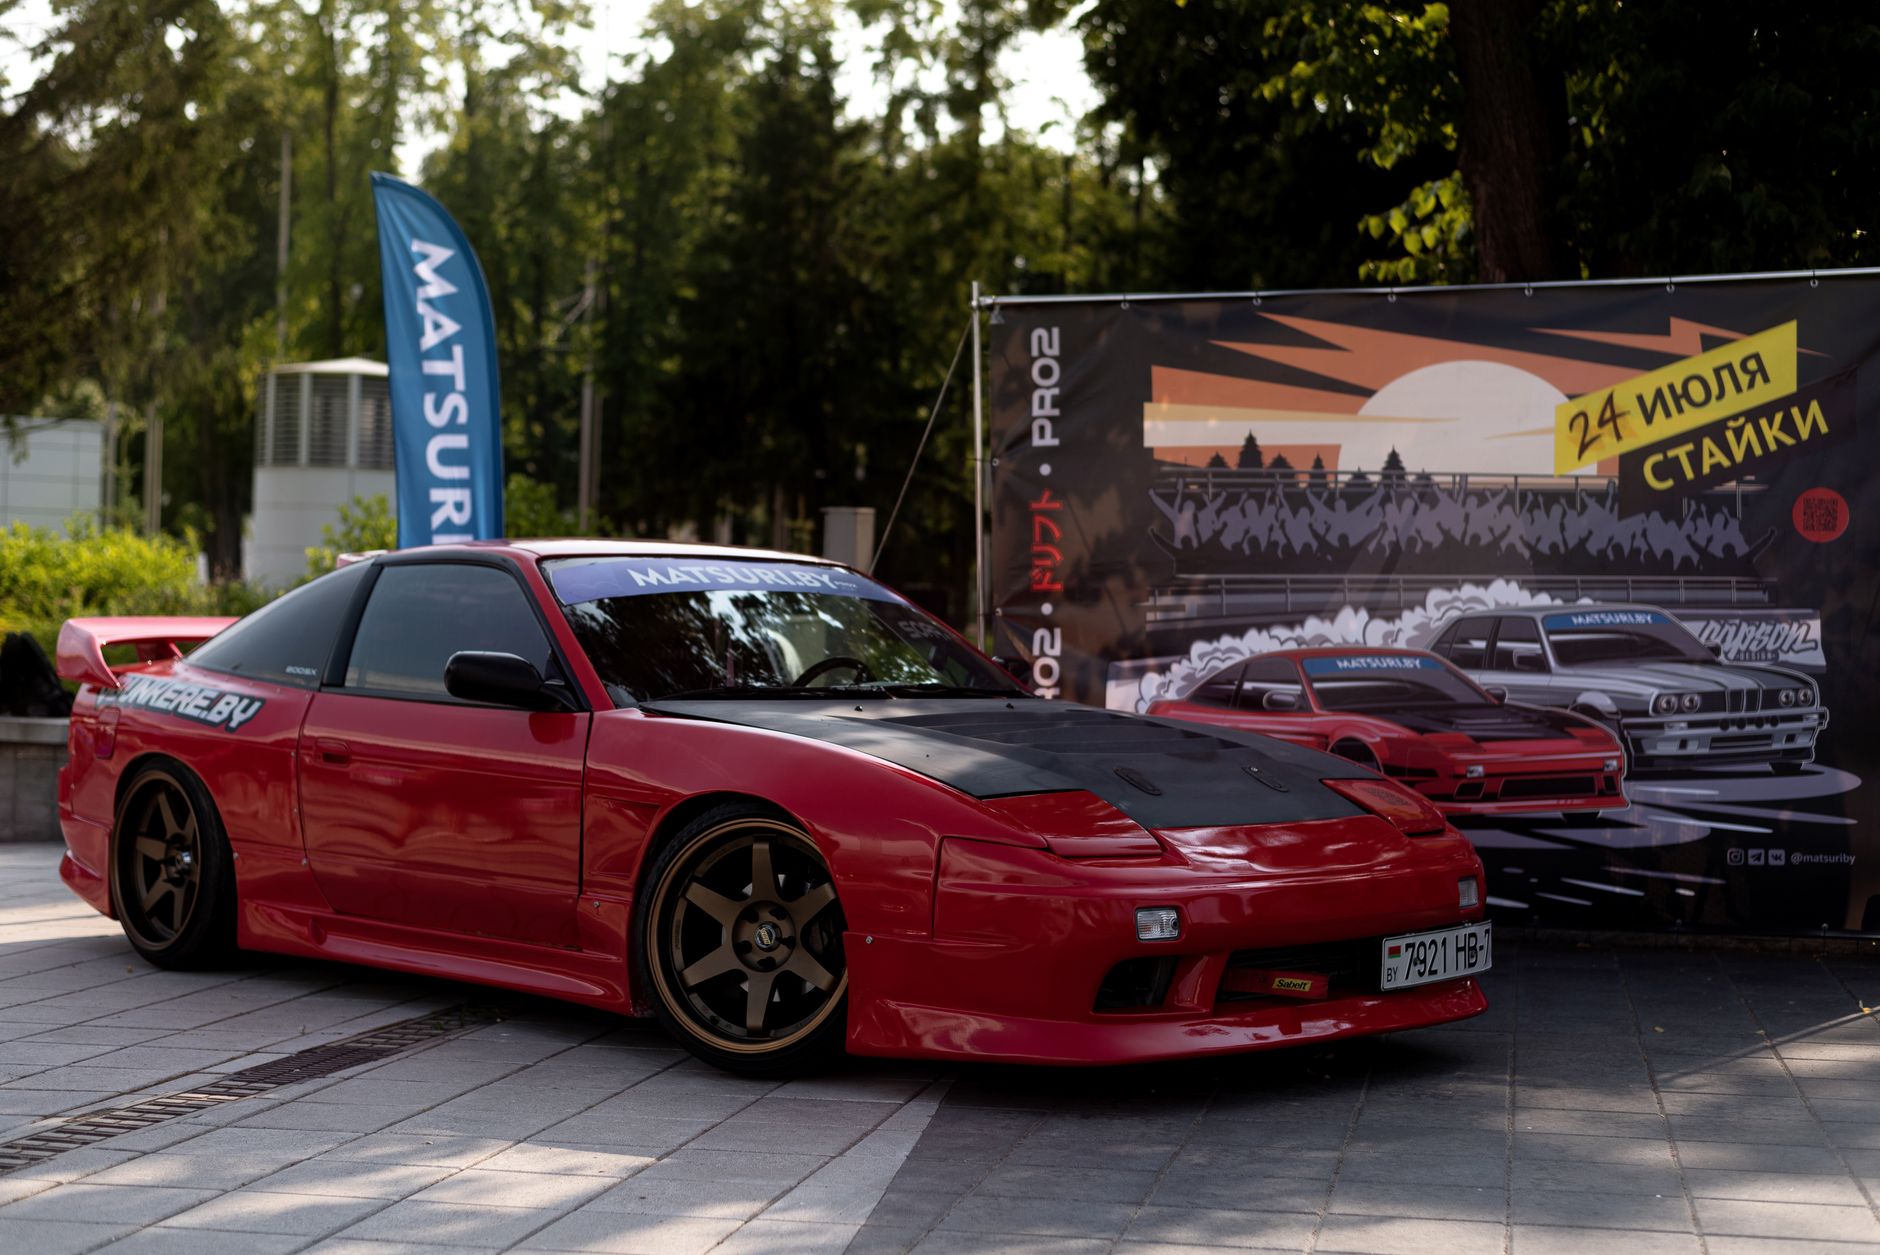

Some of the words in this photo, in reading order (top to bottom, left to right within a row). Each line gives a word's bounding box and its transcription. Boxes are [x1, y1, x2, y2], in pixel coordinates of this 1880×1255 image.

[1031, 326, 1061, 447] PRO2
[1568, 390, 1631, 462] 24
[1635, 351, 1771, 427] ИЮЛЯ
[1642, 399, 1830, 491] СТАЙКИ
[1029, 488, 1064, 593] ドリフト
[626, 566, 838, 590] MATSURI.BY
[1790, 851, 1856, 865] @matsuriby
[1386, 966, 1399, 983] BY
[1404, 936, 1448, 980] 7921
[1454, 928, 1491, 970] HB-7
